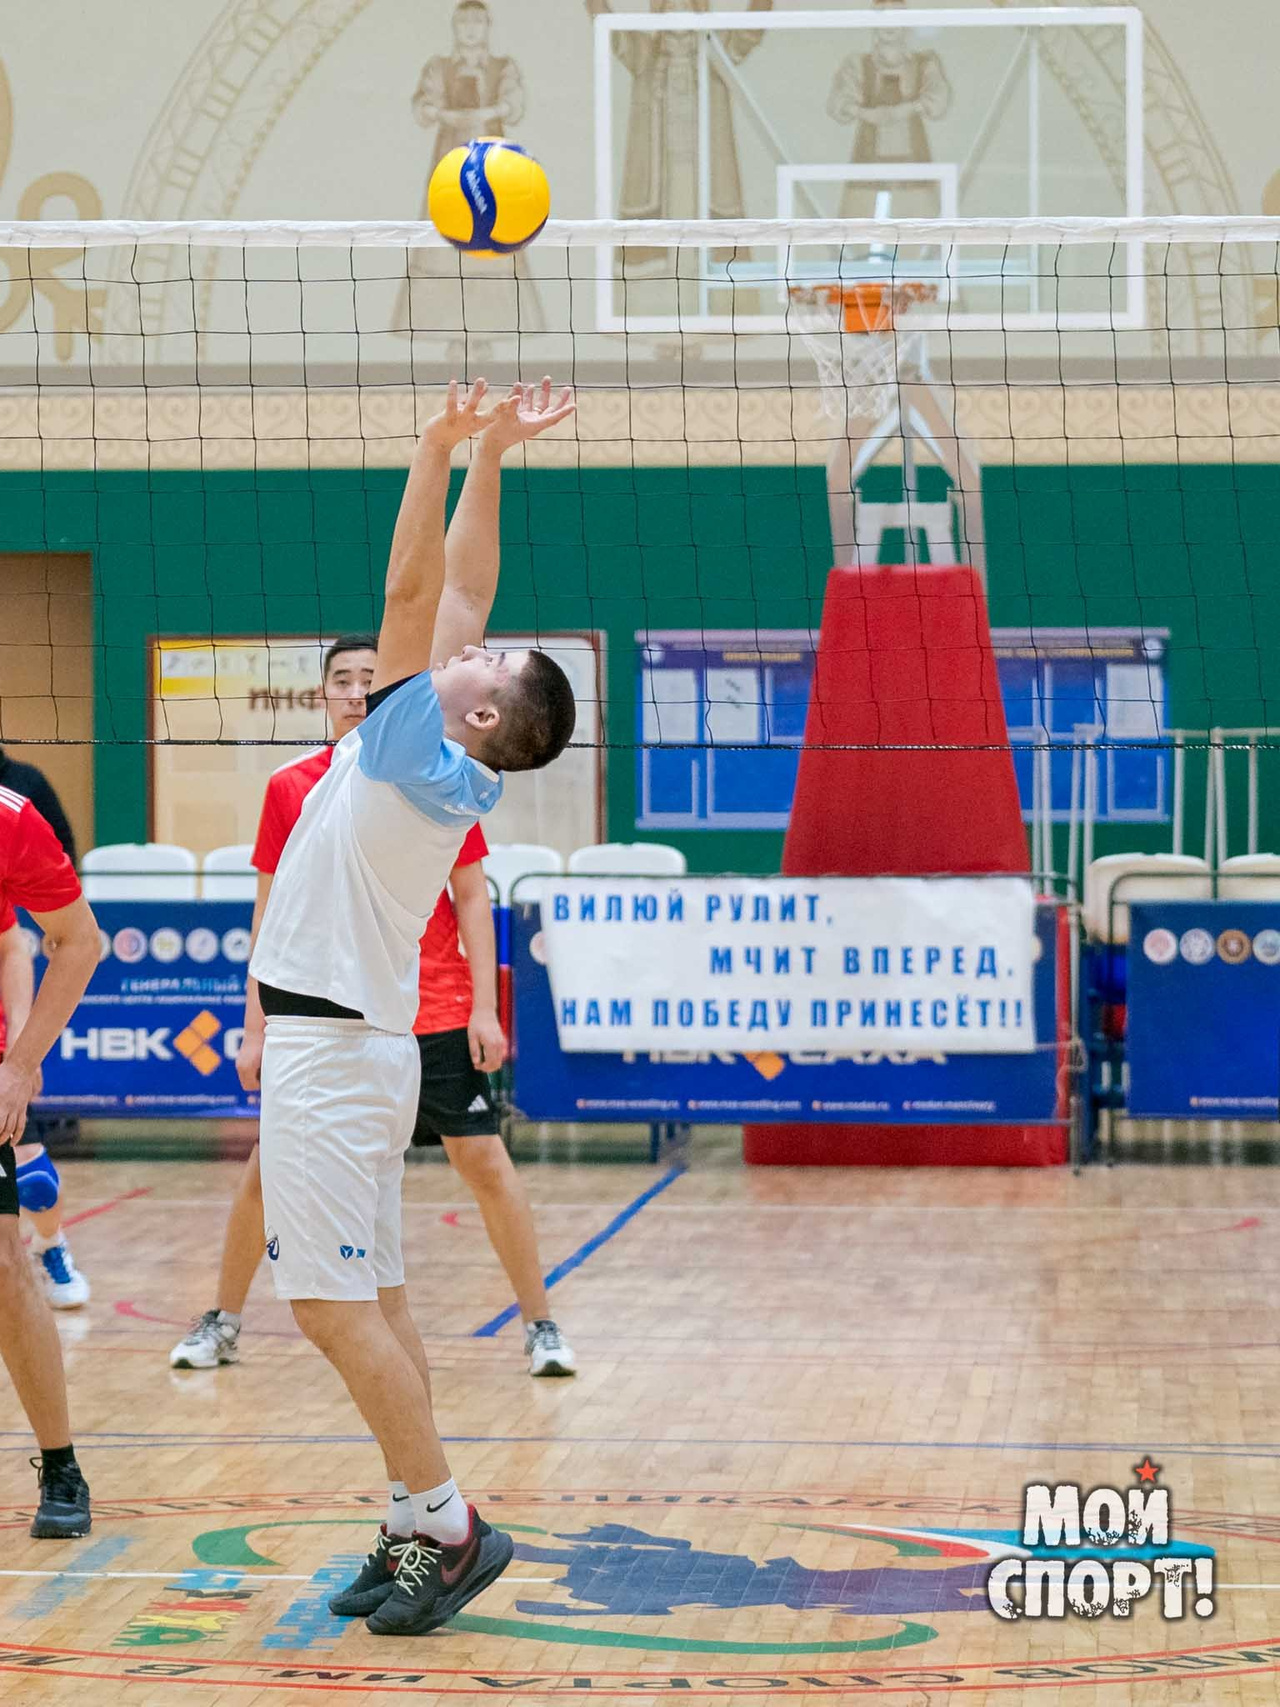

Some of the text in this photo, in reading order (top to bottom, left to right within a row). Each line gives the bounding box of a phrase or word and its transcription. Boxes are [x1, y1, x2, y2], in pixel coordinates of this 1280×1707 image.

[553, 888, 833, 926] ВИЛЮЙ РУЛИТ,
[709, 946, 818, 975] МЧИТ
[561, 993, 1023, 1030] НАМ ПОБЕДУ ПРИНЕСЁТ!!
[60, 1027, 175, 1061] НВК
[992, 1647, 1280, 1680] ИДОВ
[470, 1673, 965, 1691] СПОРТА
